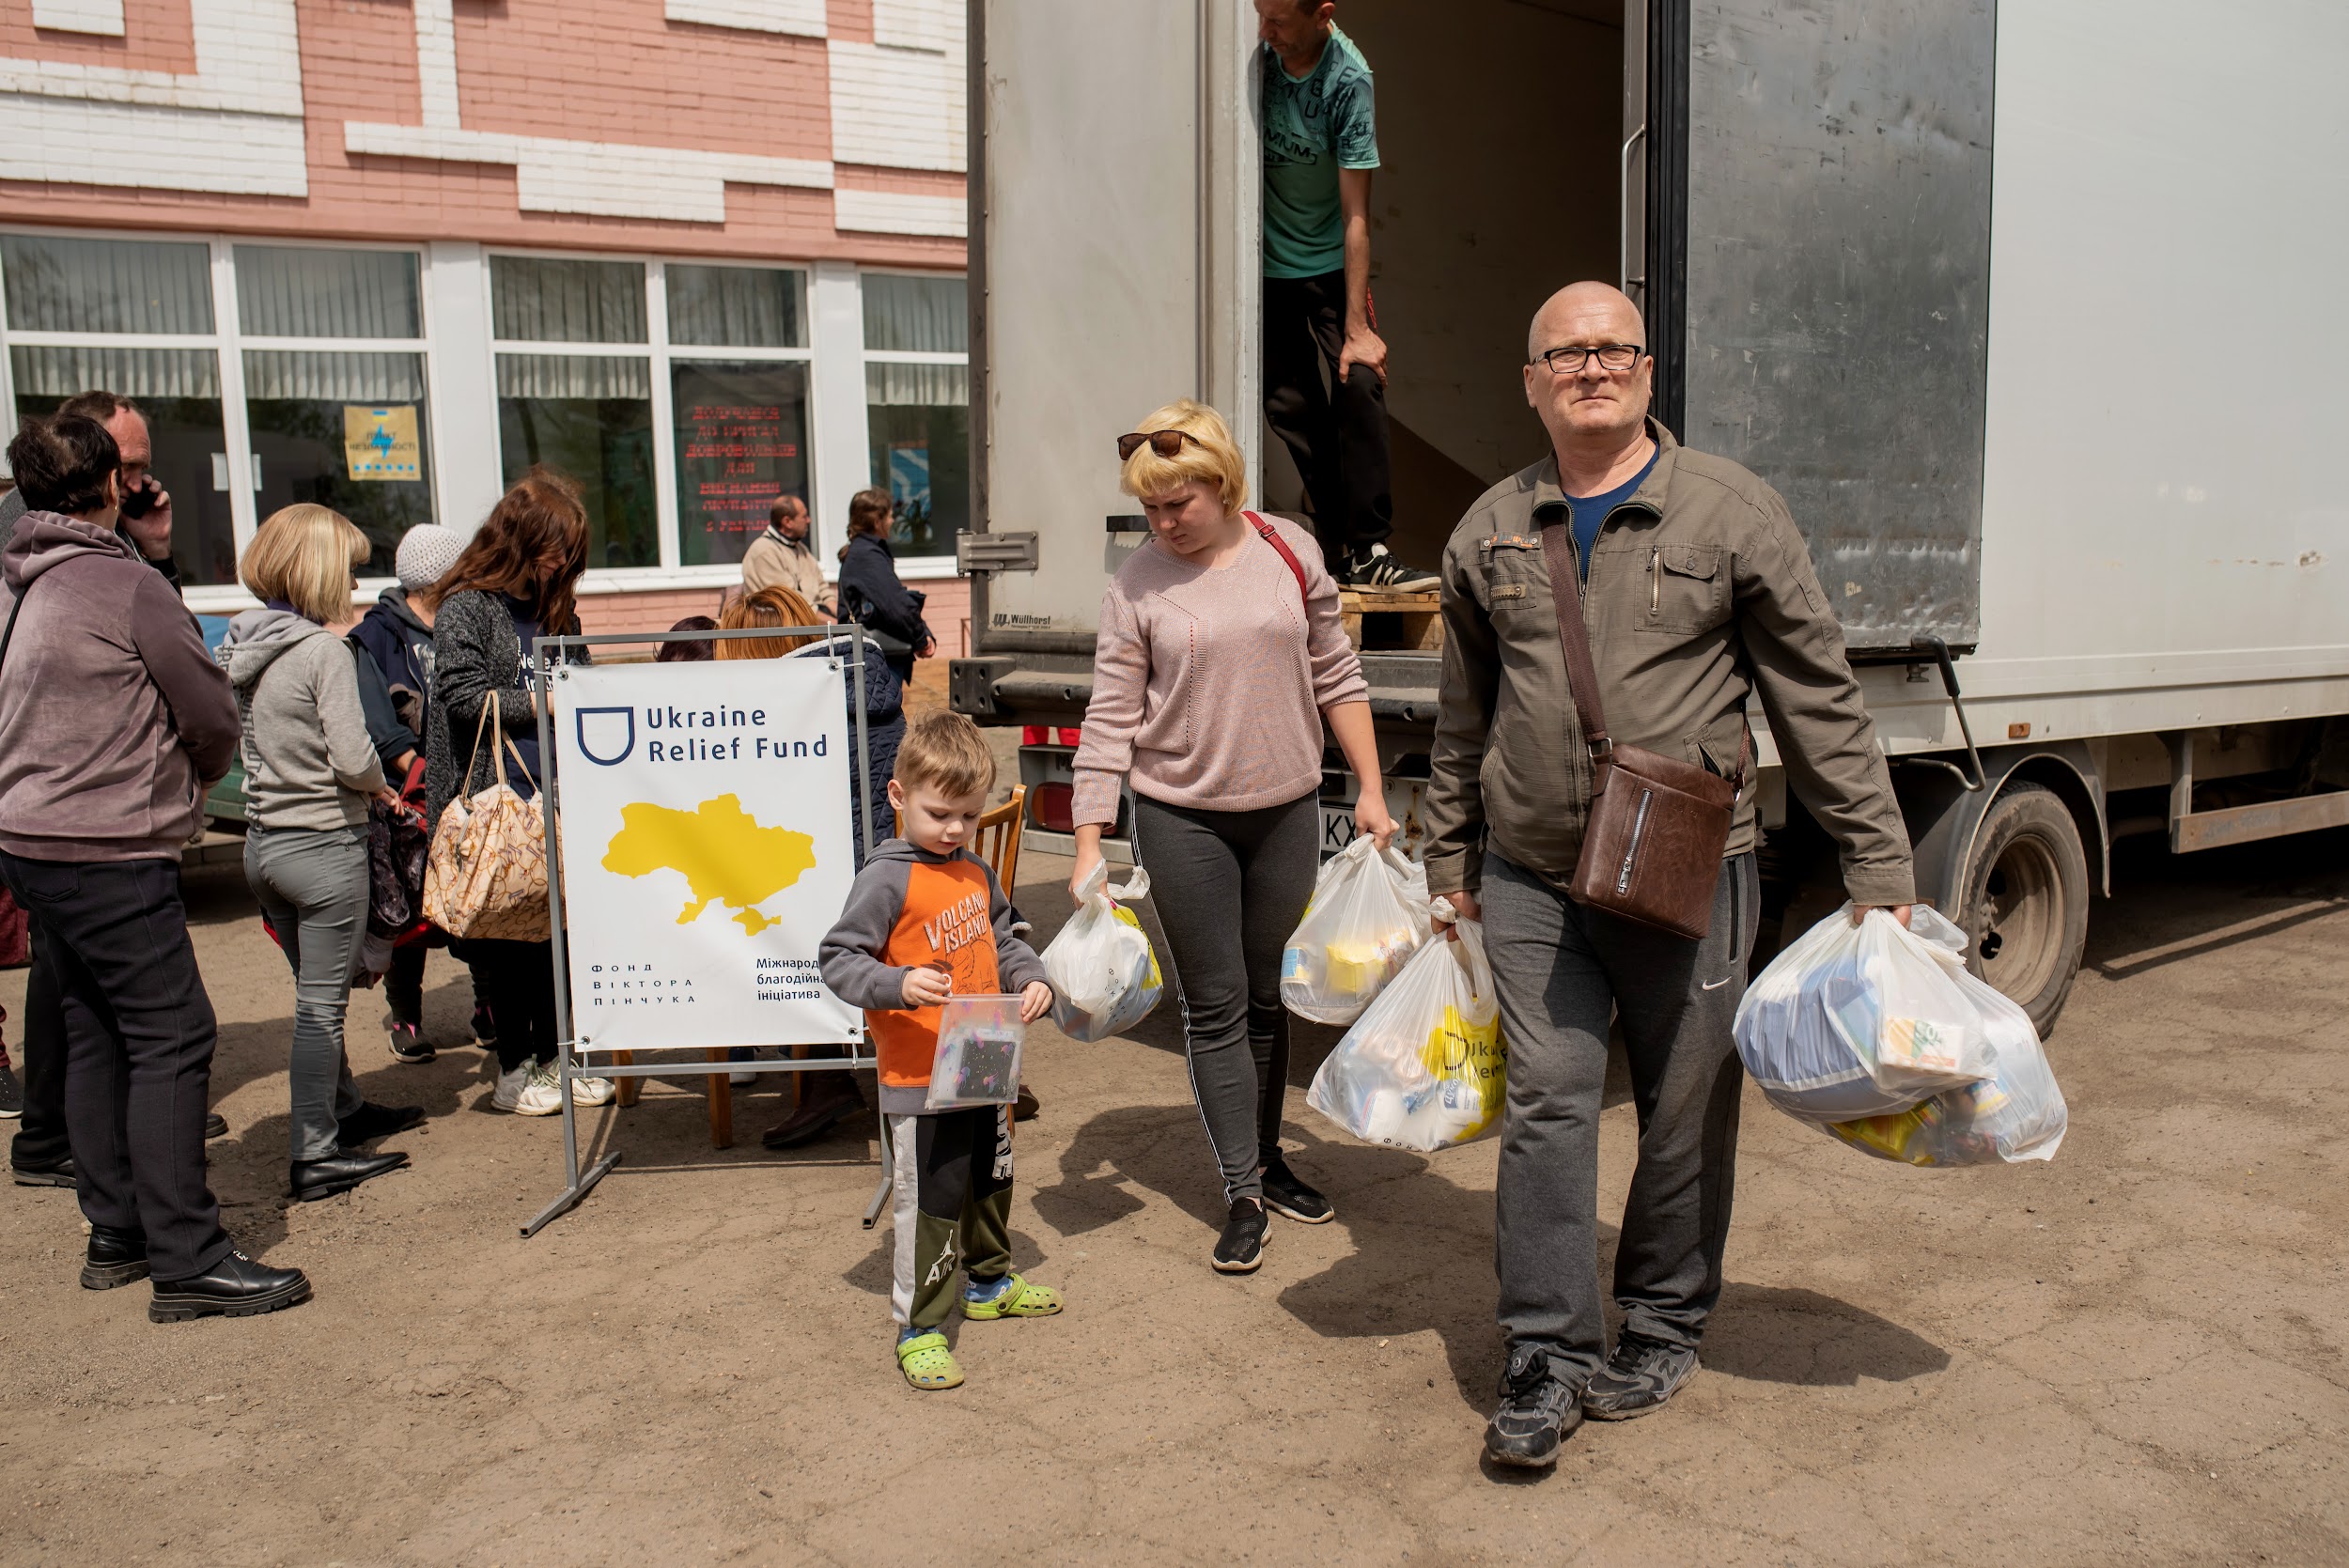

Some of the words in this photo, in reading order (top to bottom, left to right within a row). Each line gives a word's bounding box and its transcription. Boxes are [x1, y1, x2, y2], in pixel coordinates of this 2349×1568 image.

[647, 705, 766, 729] Ukraine
[649, 737, 739, 762] Relief
[756, 734, 827, 759] Fund
[925, 891, 986, 952] VOLCANO
[944, 912, 988, 954] ISLAND
[591, 964, 652, 972] ФОНД
[593, 979, 692, 989] ВІКТОРА
[594, 996, 694, 1006] ПІНЧУКА
[757, 989, 820, 1002] ініціатива
